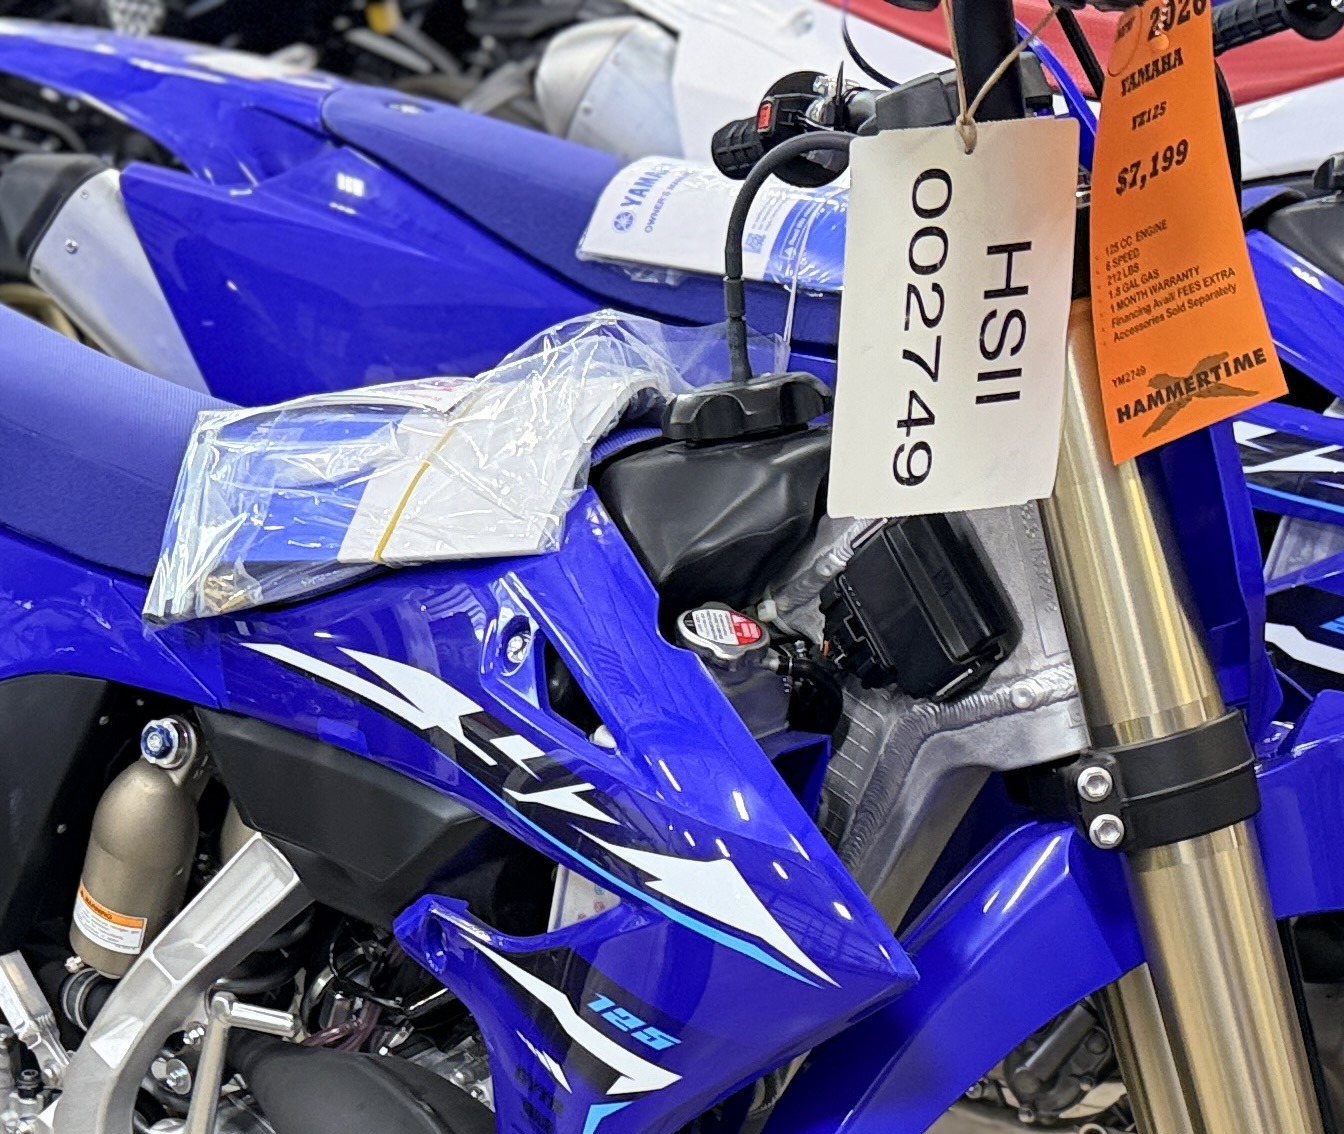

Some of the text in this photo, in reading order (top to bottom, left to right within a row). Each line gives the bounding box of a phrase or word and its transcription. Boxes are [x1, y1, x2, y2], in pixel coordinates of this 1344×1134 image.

[1121, 47, 1184, 97] YAMAHA
[1131, 101, 1168, 131] YZ125
[1115, 139, 1189, 196] $7,199
[1112, 247, 1140, 268] SPEED
[1120, 235, 1133, 249] CC
[1135, 219, 1168, 242] ENGINE
[1107, 263, 1140, 287] 212 LBS
[1111, 304, 1152, 330] Financing
[1177, 281, 1202, 301] FEES
[1203, 267, 1236, 288] EXTRA
[1116, 287, 1149, 311] MONTH
[1149, 265, 1200, 298] WARRANTY
[1122, 276, 1140, 293] GAL
[1141, 268, 1160, 286] GAS
[891, 168, 953, 488] 002749
[974, 240, 1033, 405] HSII
[1113, 282, 1238, 343] Accessories Sold Separately
[1116, 347, 1268, 424] HAMMERTIME
[587, 992, 682, 1051] 125
